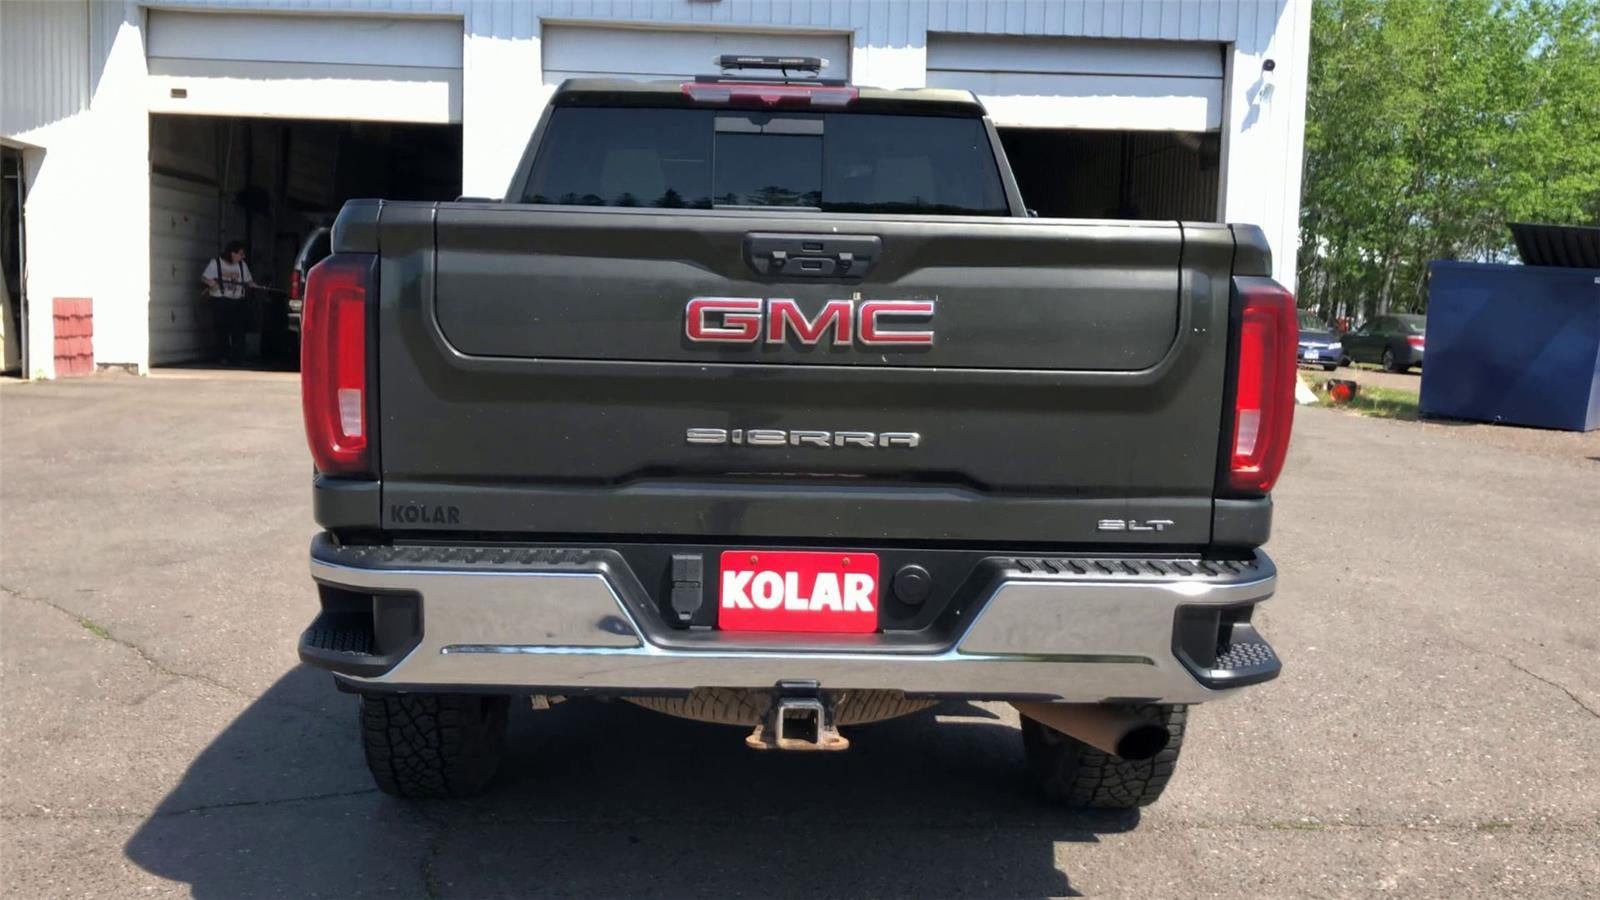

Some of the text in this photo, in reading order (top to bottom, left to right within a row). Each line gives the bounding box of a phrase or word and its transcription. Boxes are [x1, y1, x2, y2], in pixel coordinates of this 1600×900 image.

[685, 297, 935, 345] GMC
[686, 428, 921, 448] SIERRA
[391, 504, 461, 524] KOLAR
[1097, 519, 1175, 532] SLT
[721, 570, 875, 612] KOLAR
